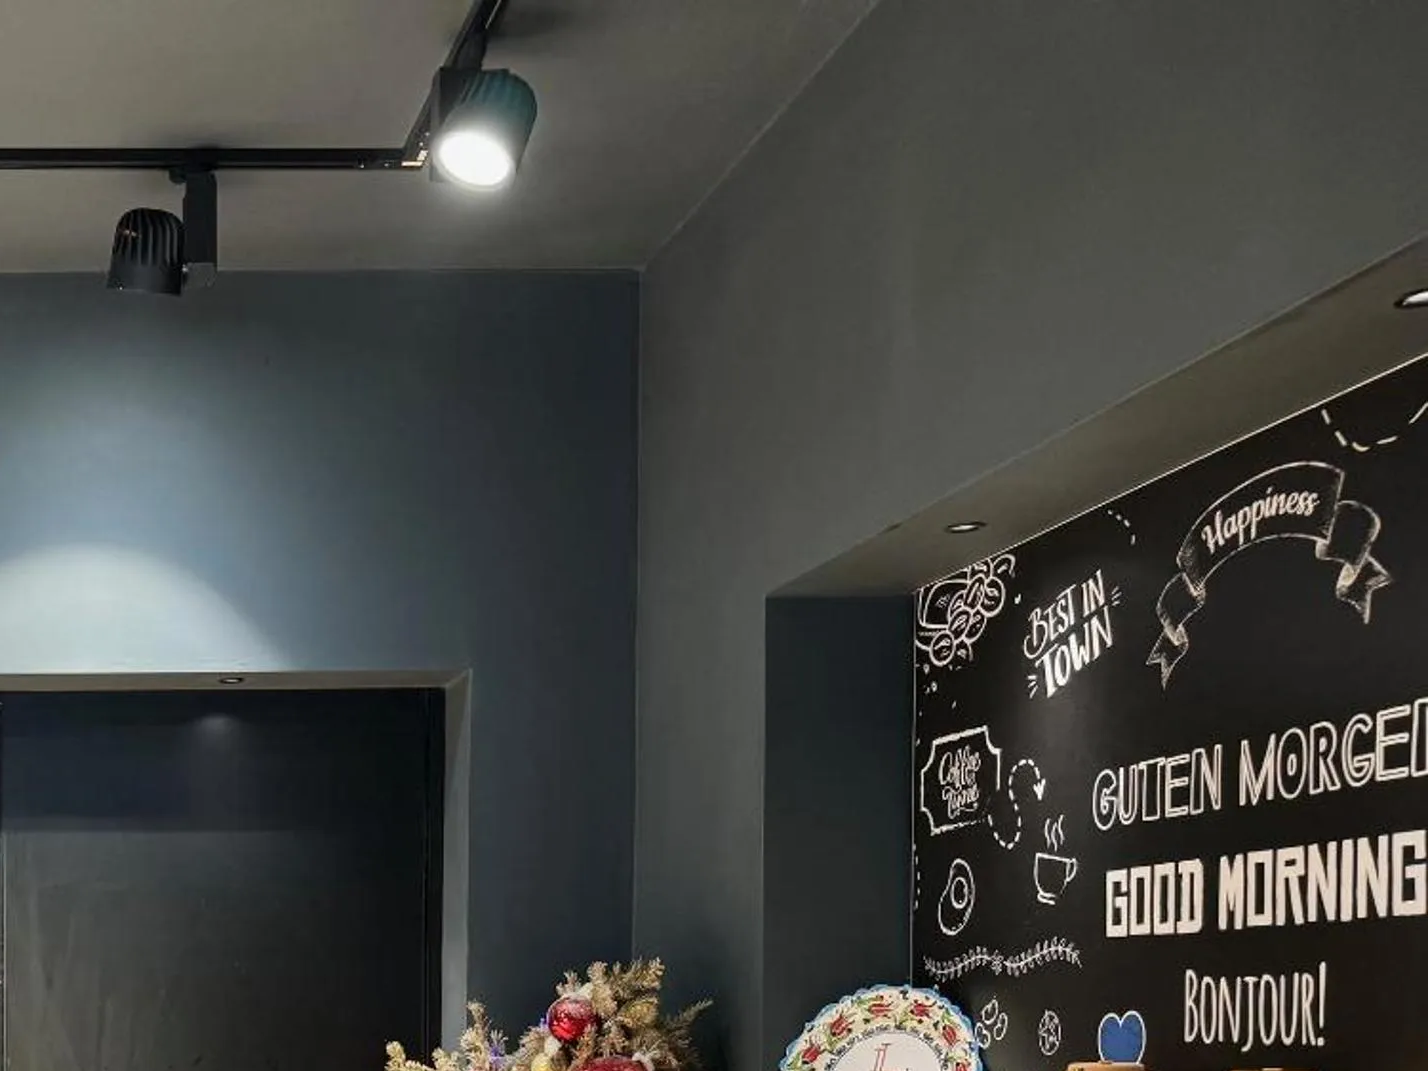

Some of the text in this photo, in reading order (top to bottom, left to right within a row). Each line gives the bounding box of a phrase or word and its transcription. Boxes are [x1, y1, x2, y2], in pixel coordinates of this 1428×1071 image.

[1201, 487, 1321, 554] Happiness
[1024, 569, 1106, 659] BEST IN
[1035, 606, 1113, 699] TOWN
[1092, 744, 1222, 830] GUTEN
[1106, 830, 1427, 938] GOOD MORNING
[1184, 961, 1327, 1052] BONJOUR!
